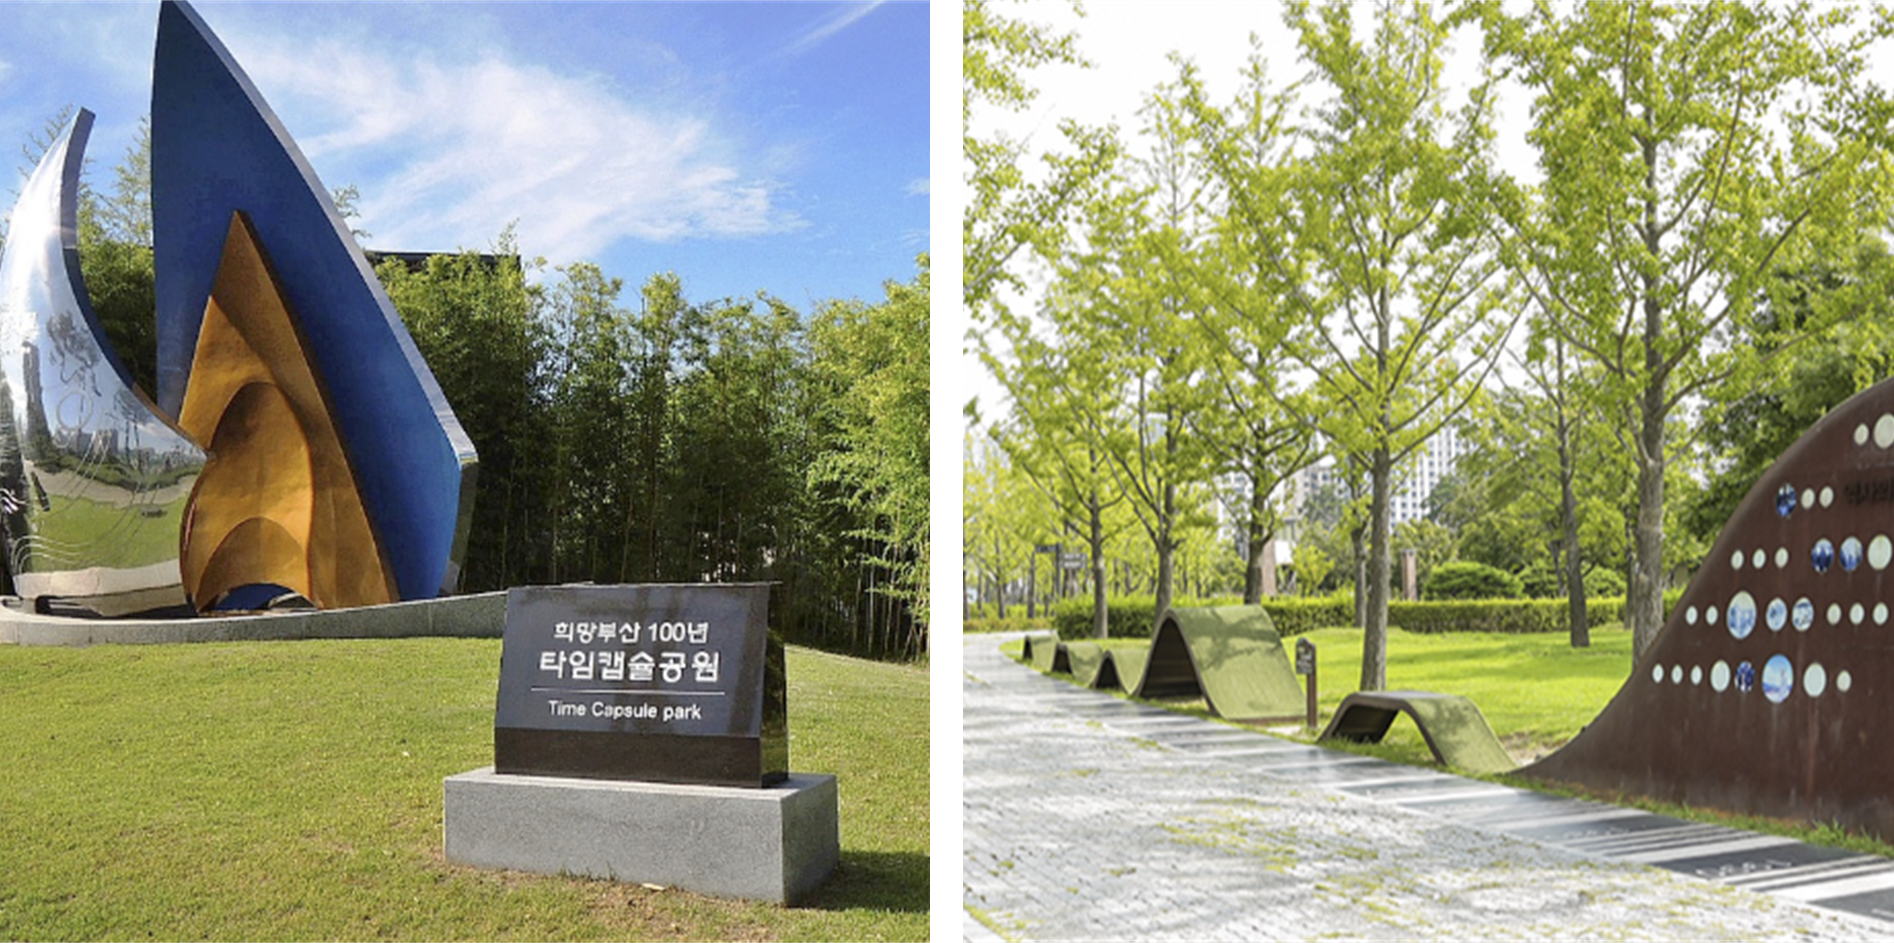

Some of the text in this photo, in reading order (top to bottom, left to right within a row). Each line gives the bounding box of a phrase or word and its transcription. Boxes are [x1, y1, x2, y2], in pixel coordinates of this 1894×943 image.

[554, 622, 709, 644] 희망부산 100년
[540, 651, 720, 683] 타임캡슐공원
[549, 700, 702, 721] Time Capsule park
